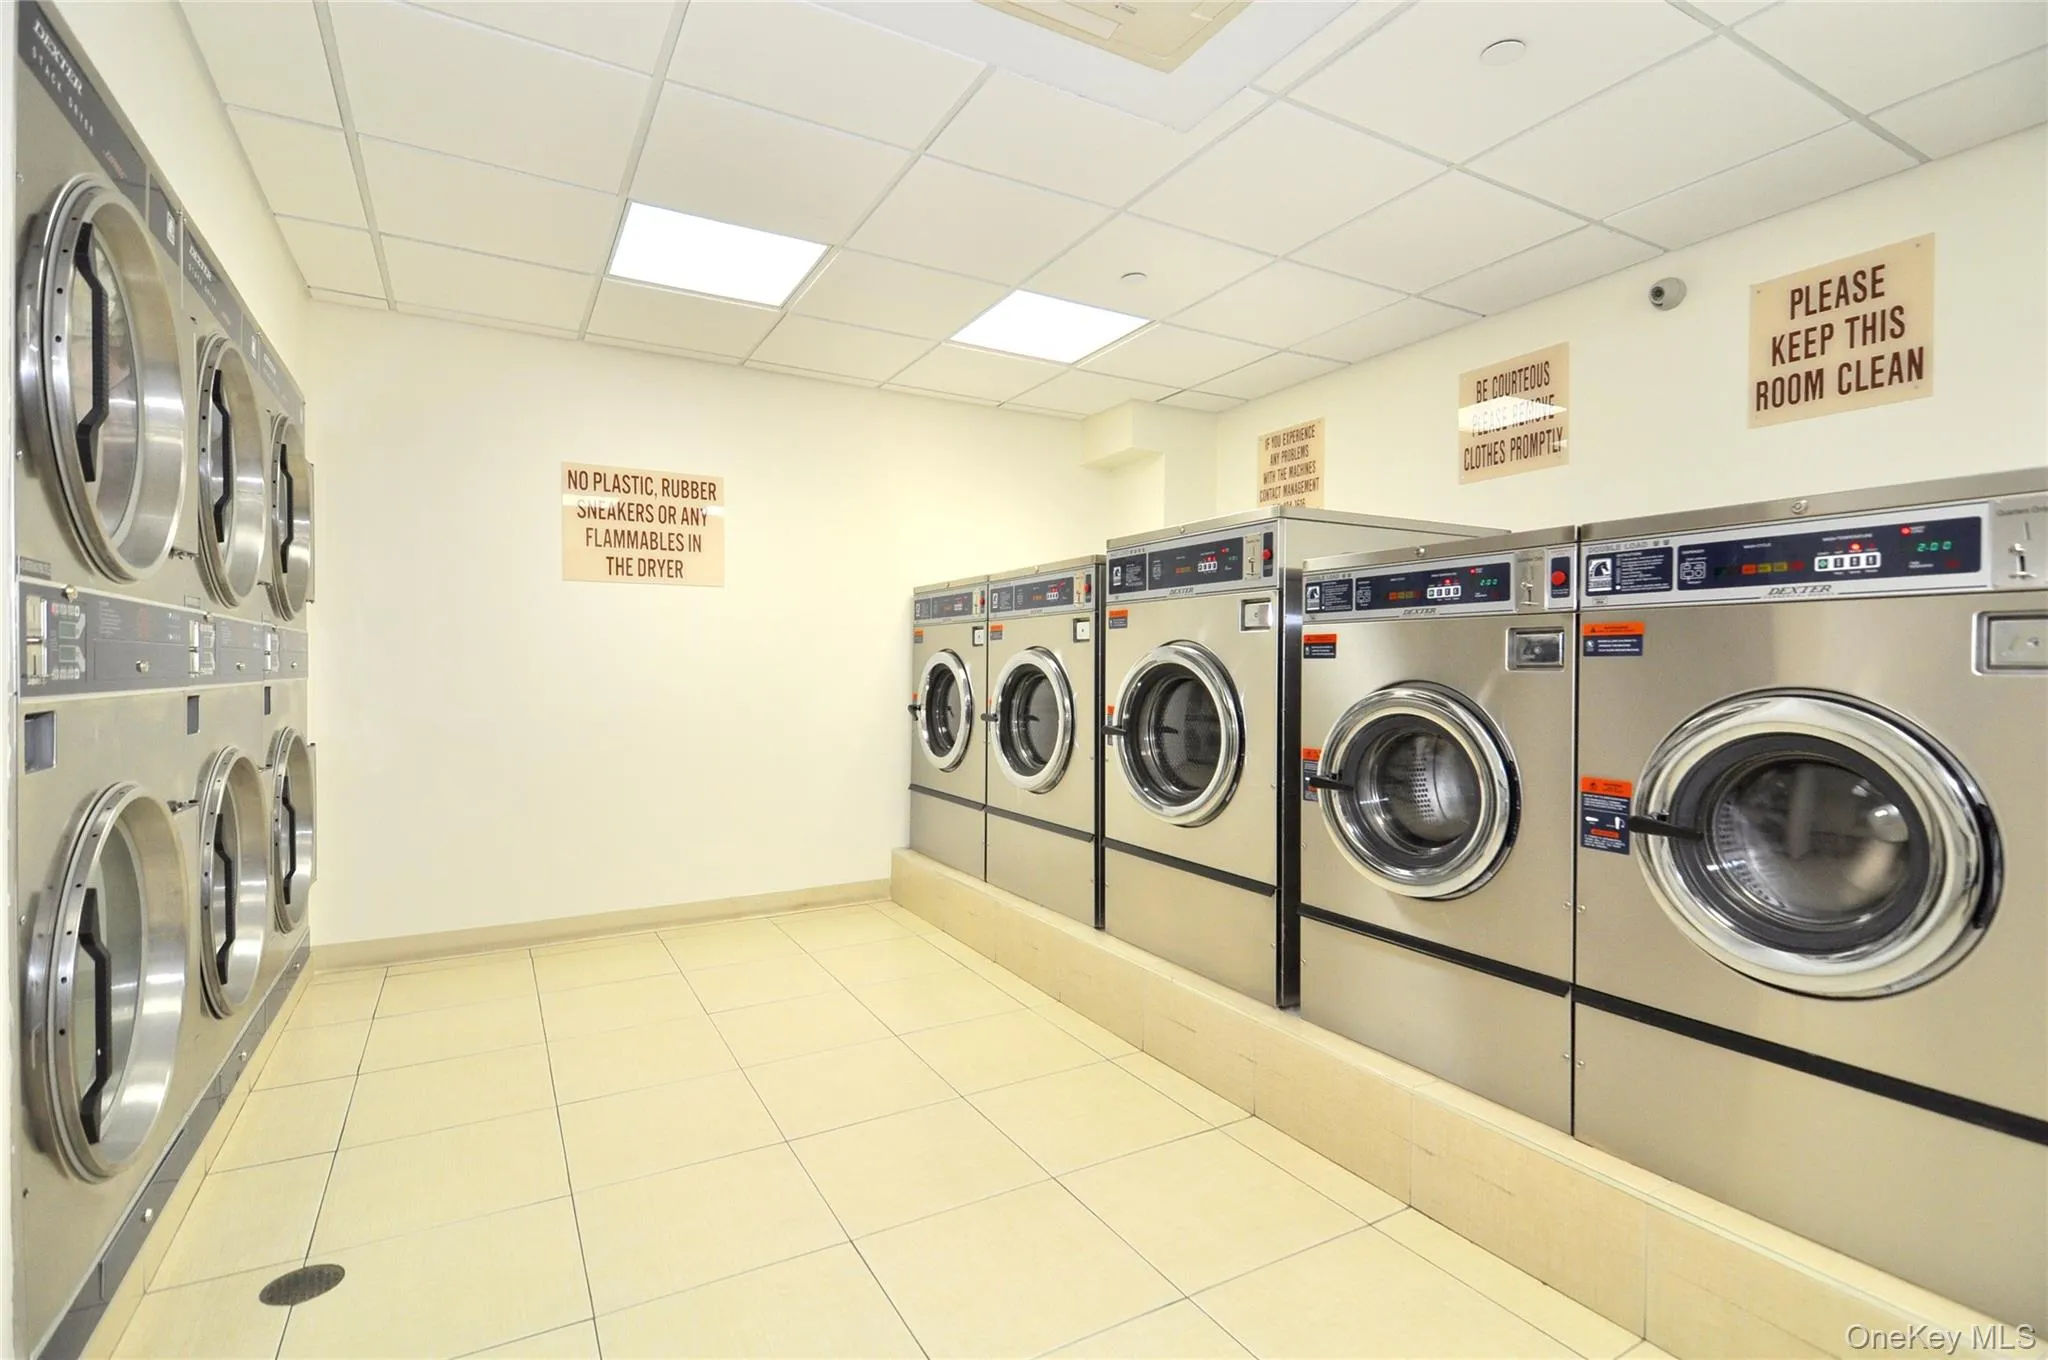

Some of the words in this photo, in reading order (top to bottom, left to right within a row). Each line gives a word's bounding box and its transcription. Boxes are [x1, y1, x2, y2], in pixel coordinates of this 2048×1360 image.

[32, 20, 83, 96] DEXTER
[1789, 264, 1886, 320] PLEASE
[1771, 322, 1834, 367] KEEP
[1844, 304, 1906, 349] THIS
[1476, 378, 1488, 404] BE
[1492, 361, 1550, 399] COURTEOUS
[1755, 368, 1824, 412] ROOM
[1837, 346, 1924, 396] CLEAN
[1512, 394, 1555, 428] REMOVE
[1265, 437, 1270, 450] IF
[1271, 435, 1281, 448] YOU
[1282, 424, 1316, 446] EXPERIENCE
[1464, 440, 1506, 471] CLOTHES
[1510, 426, 1563, 462] PROMPTLY
[1270, 452, 1280, 466] ANY
[1281, 444, 1309, 463] PROBLEMS
[567, 469, 588, 491] NO
[593, 472, 658, 499] PLASTIC,
[661, 478, 717, 501] RUBBER
[1263, 470, 1276, 485] WITH
[1277, 467, 1287, 481] THE
[1288, 460, 1316, 478] MACHINES
[1259, 485, 1281, 503] CONTACT
[1282, 477, 1320, 497] MANAGEMENT
[577, 499, 654, 523] SNEAKERS
[658, 504, 677, 525] OR
[681, 506, 709, 527] ANY
[586, 527, 685, 552] FLAMMABLES
[688, 533, 702, 553] IN
[606, 556, 634, 577] THE
[637, 558, 684, 579] DRYER
[1768, 584, 1832, 595] DEXTER
[1402, 607, 1437, 616] DEXTER
